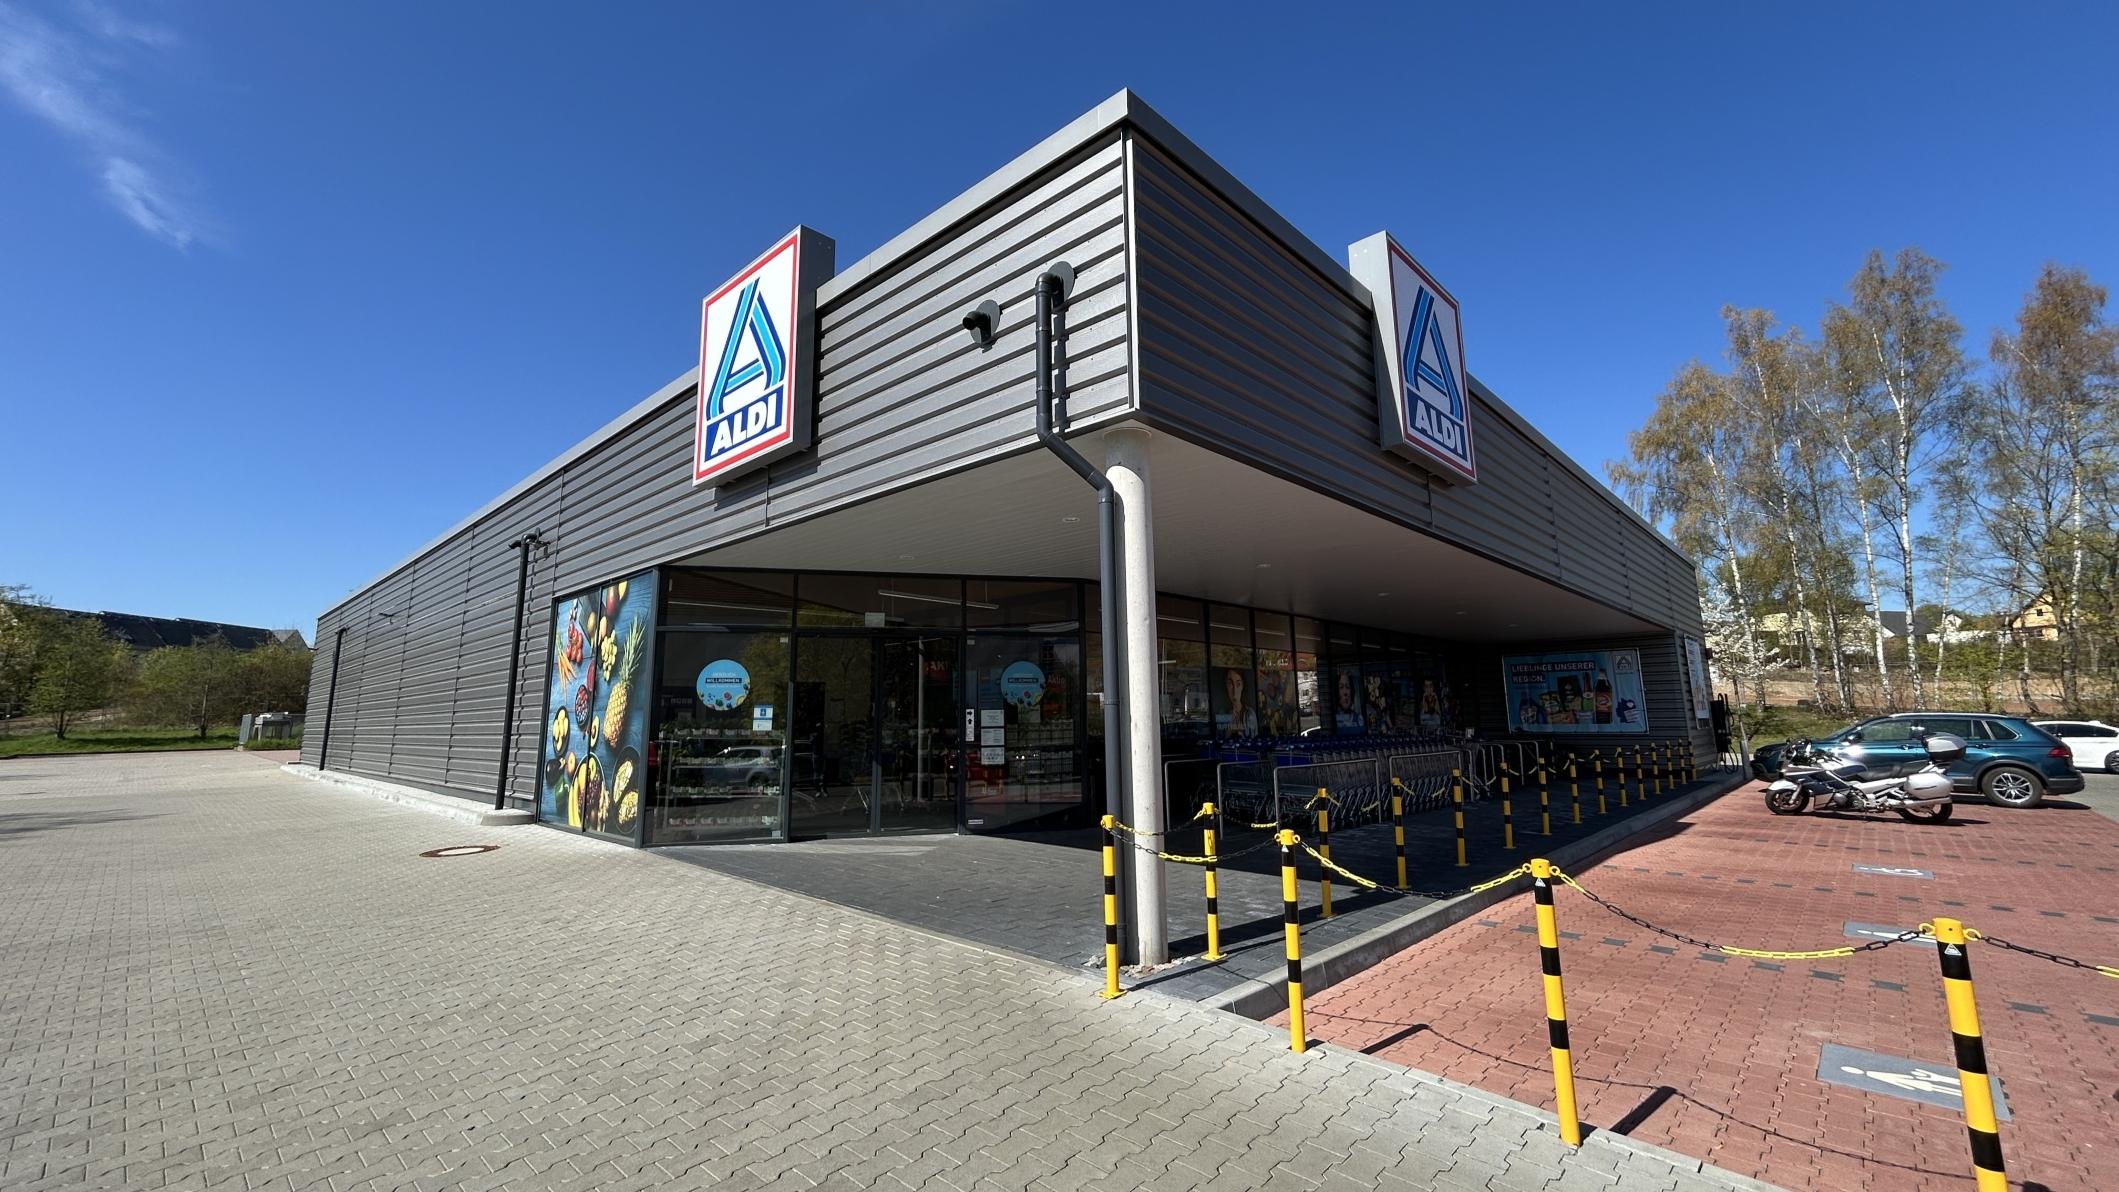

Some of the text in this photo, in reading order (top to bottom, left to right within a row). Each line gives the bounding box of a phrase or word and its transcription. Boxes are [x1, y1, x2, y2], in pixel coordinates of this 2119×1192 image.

[711, 393, 777, 456] ALDI
[1415, 400, 1463, 455] ALDI
[1554, 661, 1595, 671] UNSERER
